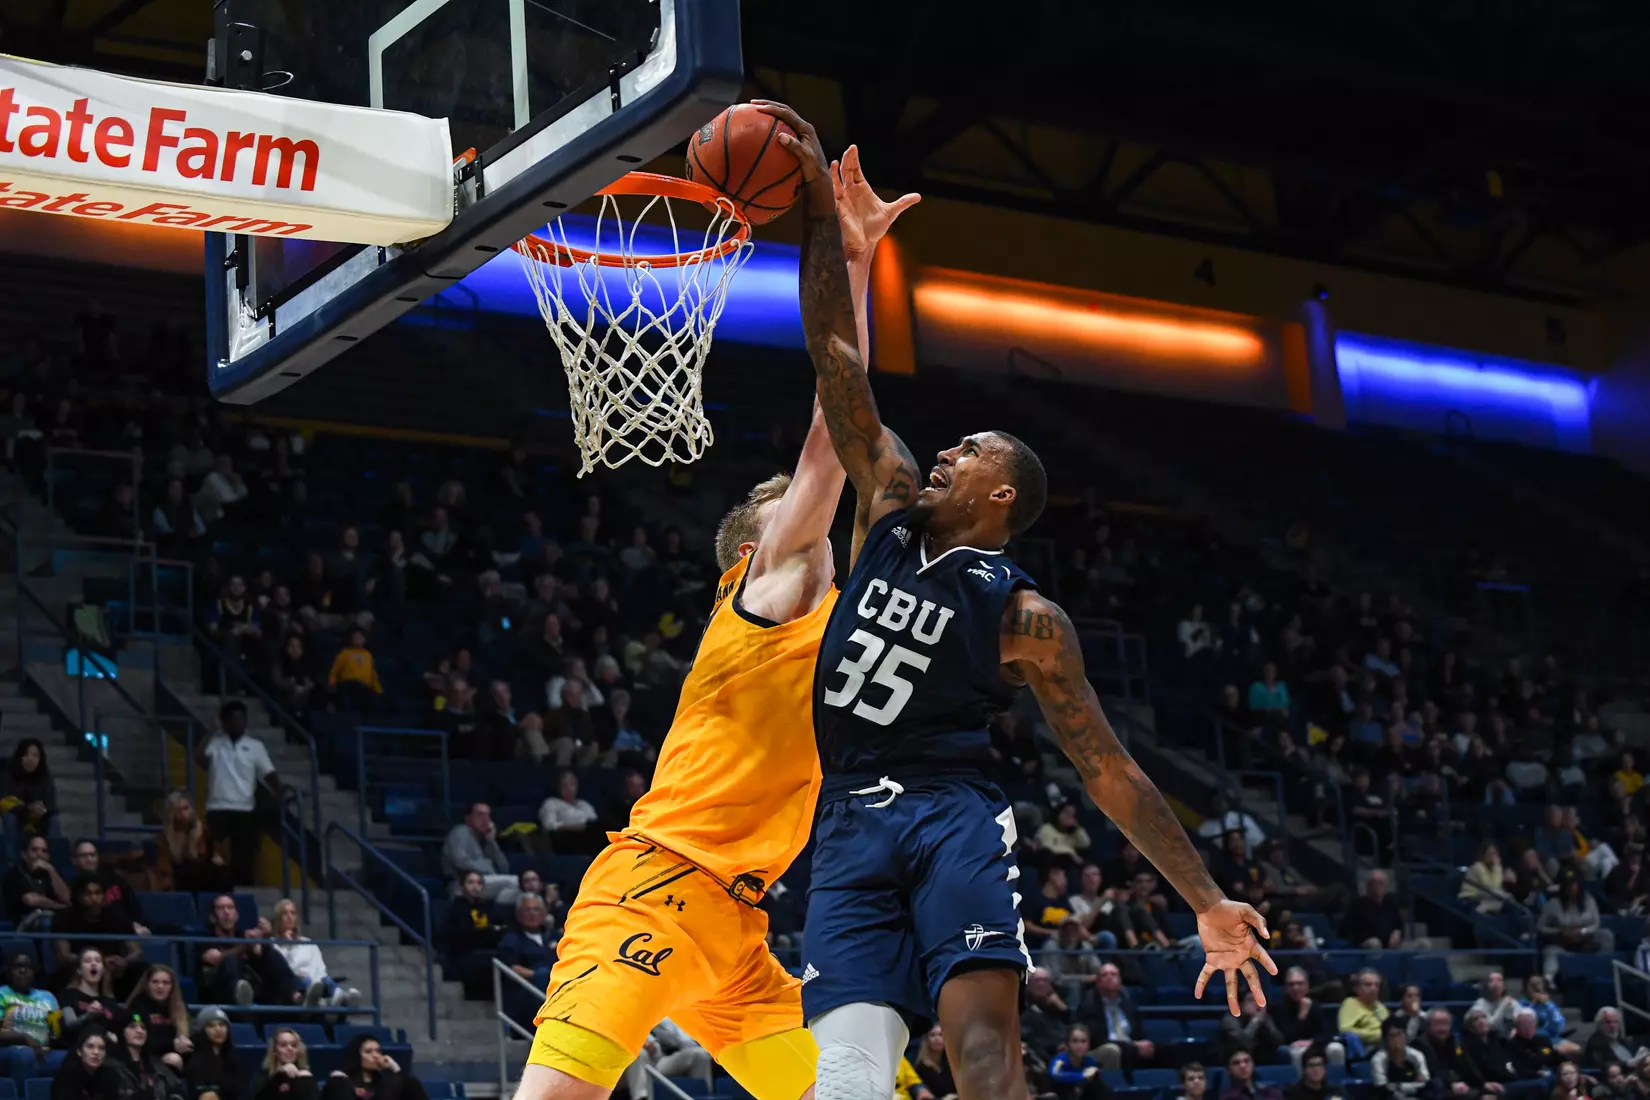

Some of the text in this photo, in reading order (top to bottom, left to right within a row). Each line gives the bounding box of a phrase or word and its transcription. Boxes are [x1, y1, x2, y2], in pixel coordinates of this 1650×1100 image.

[857, 577, 955, 646] CBU
[823, 628, 932, 726] 35
[613, 932, 674, 976] Cal
